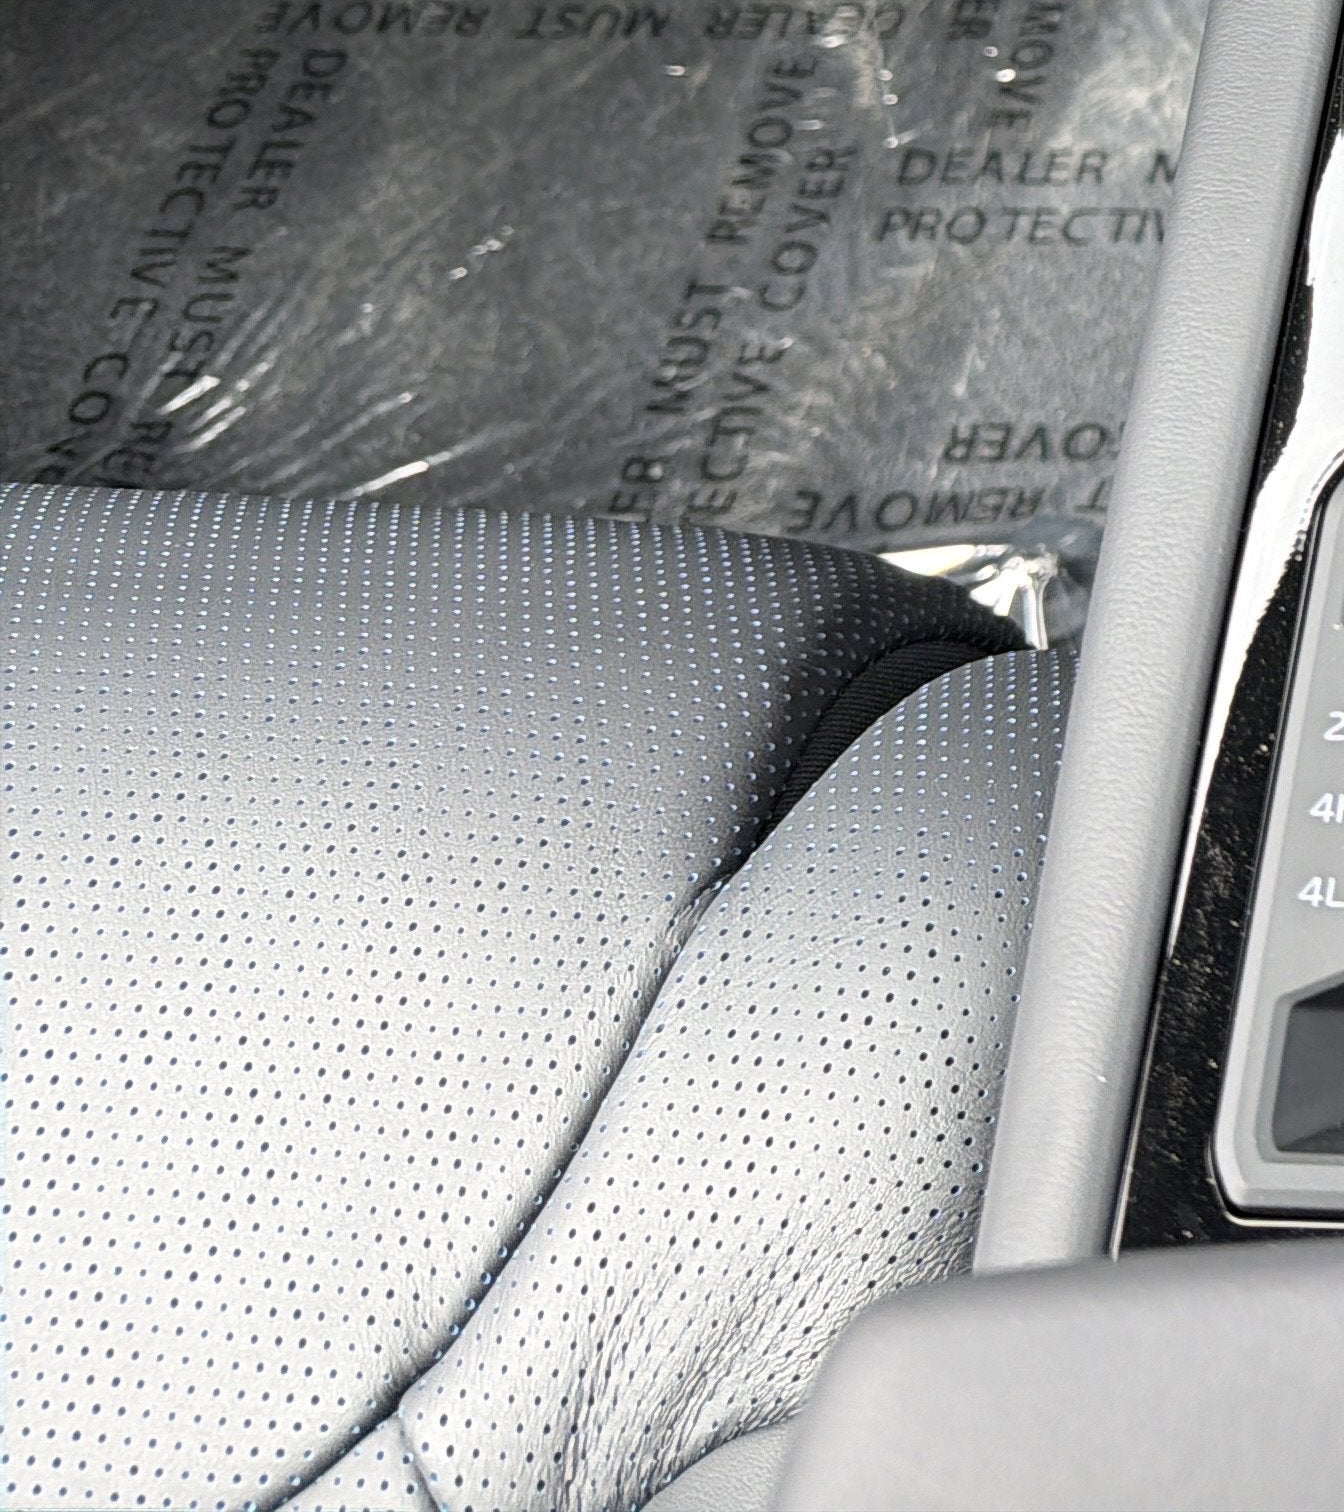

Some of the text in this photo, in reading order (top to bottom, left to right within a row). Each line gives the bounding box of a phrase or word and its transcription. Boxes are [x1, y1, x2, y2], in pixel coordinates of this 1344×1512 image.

[255, 0, 488, 38] REMOVE
[516, 2, 671, 40] MUST
[108, 47, 282, 321] PROTECTIVE
[897, 148, 1107, 185] DEALER
[162, 47, 348, 382] DEALER MUST
[757, 145, 859, 312] COVER
[873, 205, 1164, 246] PROTECTI
[786, 486, 1047, 535] REMOVE
